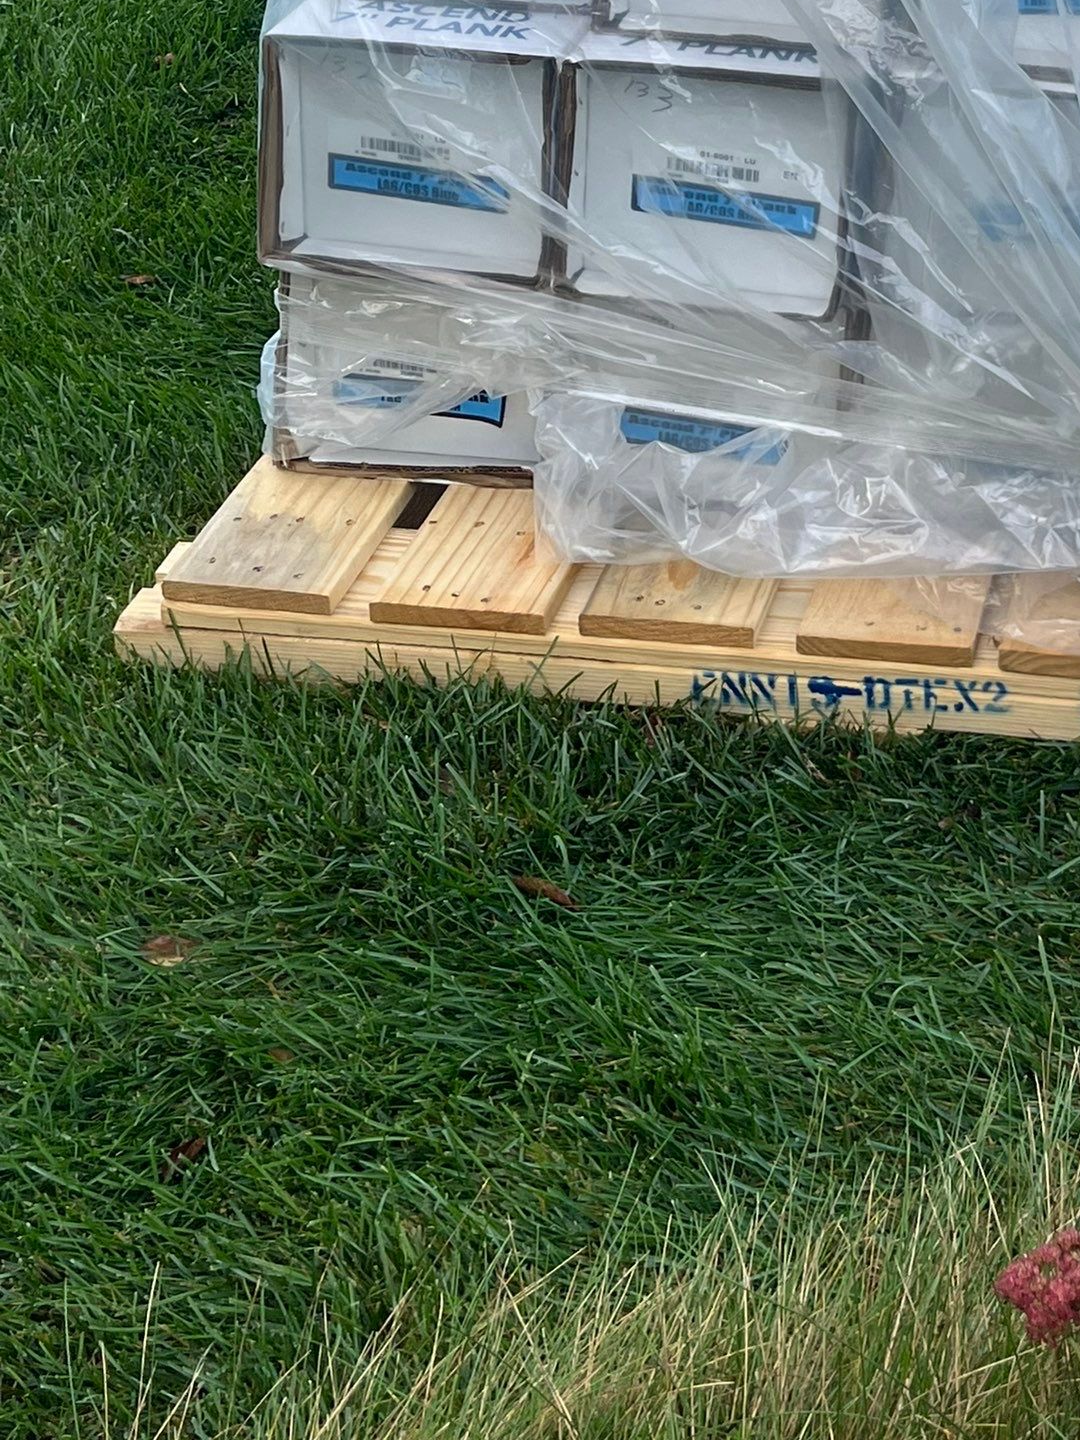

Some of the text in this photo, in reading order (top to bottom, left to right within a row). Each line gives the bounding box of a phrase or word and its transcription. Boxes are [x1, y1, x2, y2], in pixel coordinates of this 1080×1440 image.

[361, 0, 530, 23] ASCEND
[385, 15, 533, 40] PLANK
[678, 38, 818, 63] PLANK
